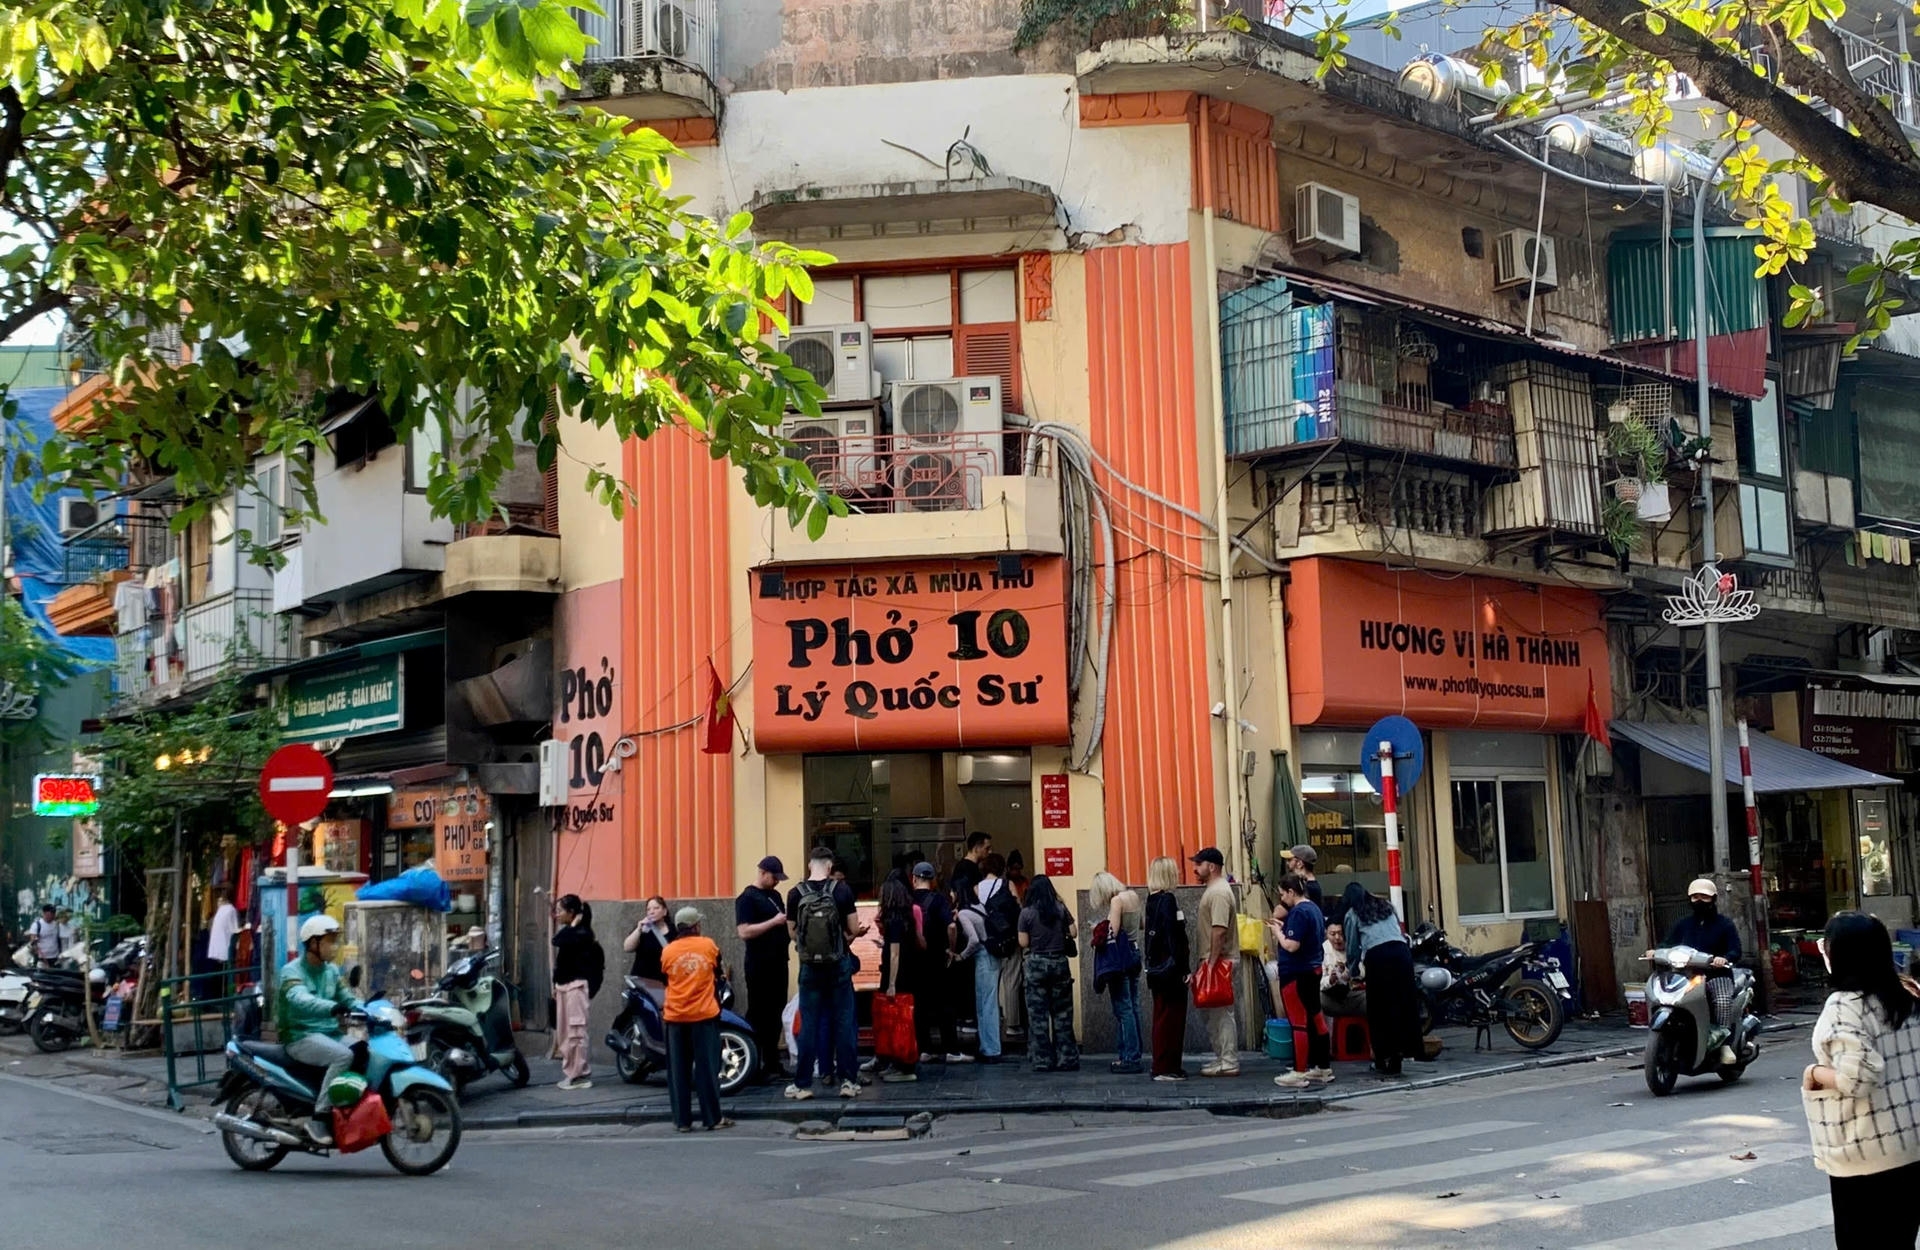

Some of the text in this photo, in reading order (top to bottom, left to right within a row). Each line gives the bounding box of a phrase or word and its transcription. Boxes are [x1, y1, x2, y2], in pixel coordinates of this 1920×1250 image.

[781, 579, 826, 603] HỢP
[834, 573, 878, 599] TÁC
[886, 571, 918, 595] XÃ
[929, 568, 983, 593] MÙA
[785, 608, 1030, 668] Phở 10
[1360, 619, 1581, 668] HƯƠNG VỊ HÀ THÀNH
[560, 656, 615, 724] Phở
[773, 670, 1044, 721] Lý Quốc Sư
[569, 731, 605, 789] 10
[600, 802, 615, 823] Sư
